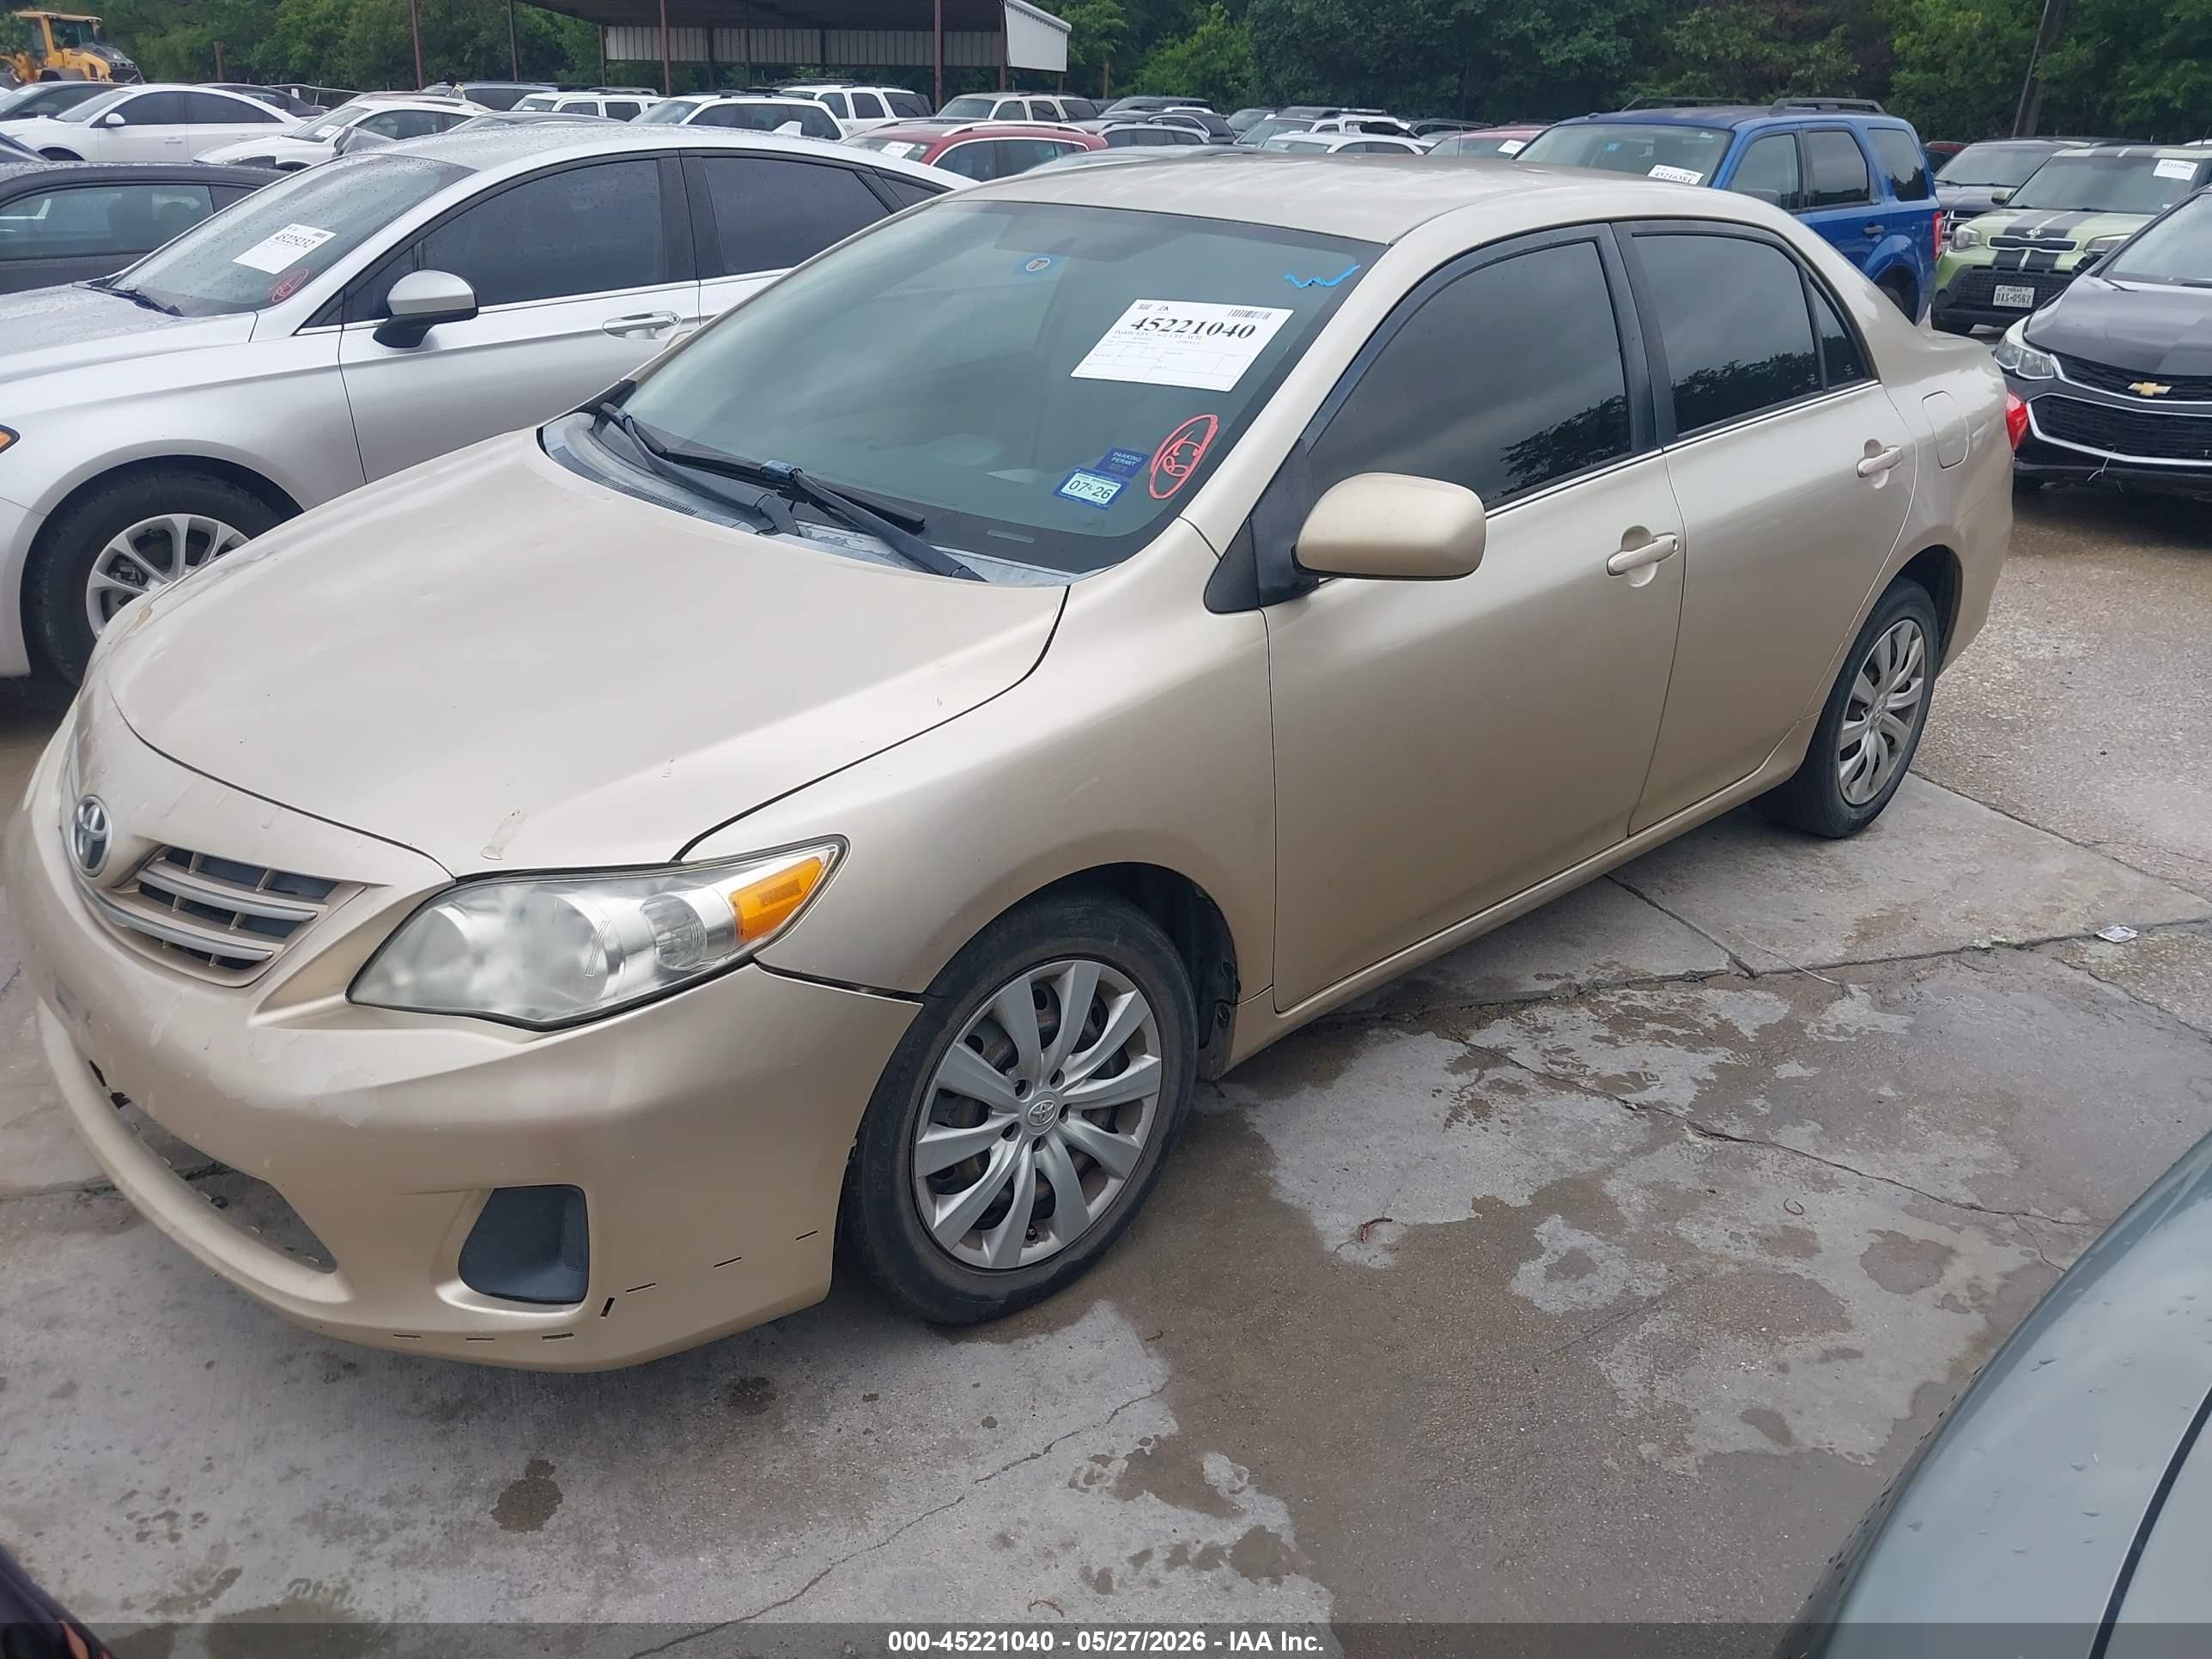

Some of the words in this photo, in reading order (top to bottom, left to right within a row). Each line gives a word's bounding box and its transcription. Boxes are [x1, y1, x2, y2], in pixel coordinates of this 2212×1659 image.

[1130, 316, 1256, 339] 45221040
[1111, 457, 1137, 467] PERMIT
[1113, 451, 1142, 464] PARKING
[1091, 486, 1114, 500] 26
